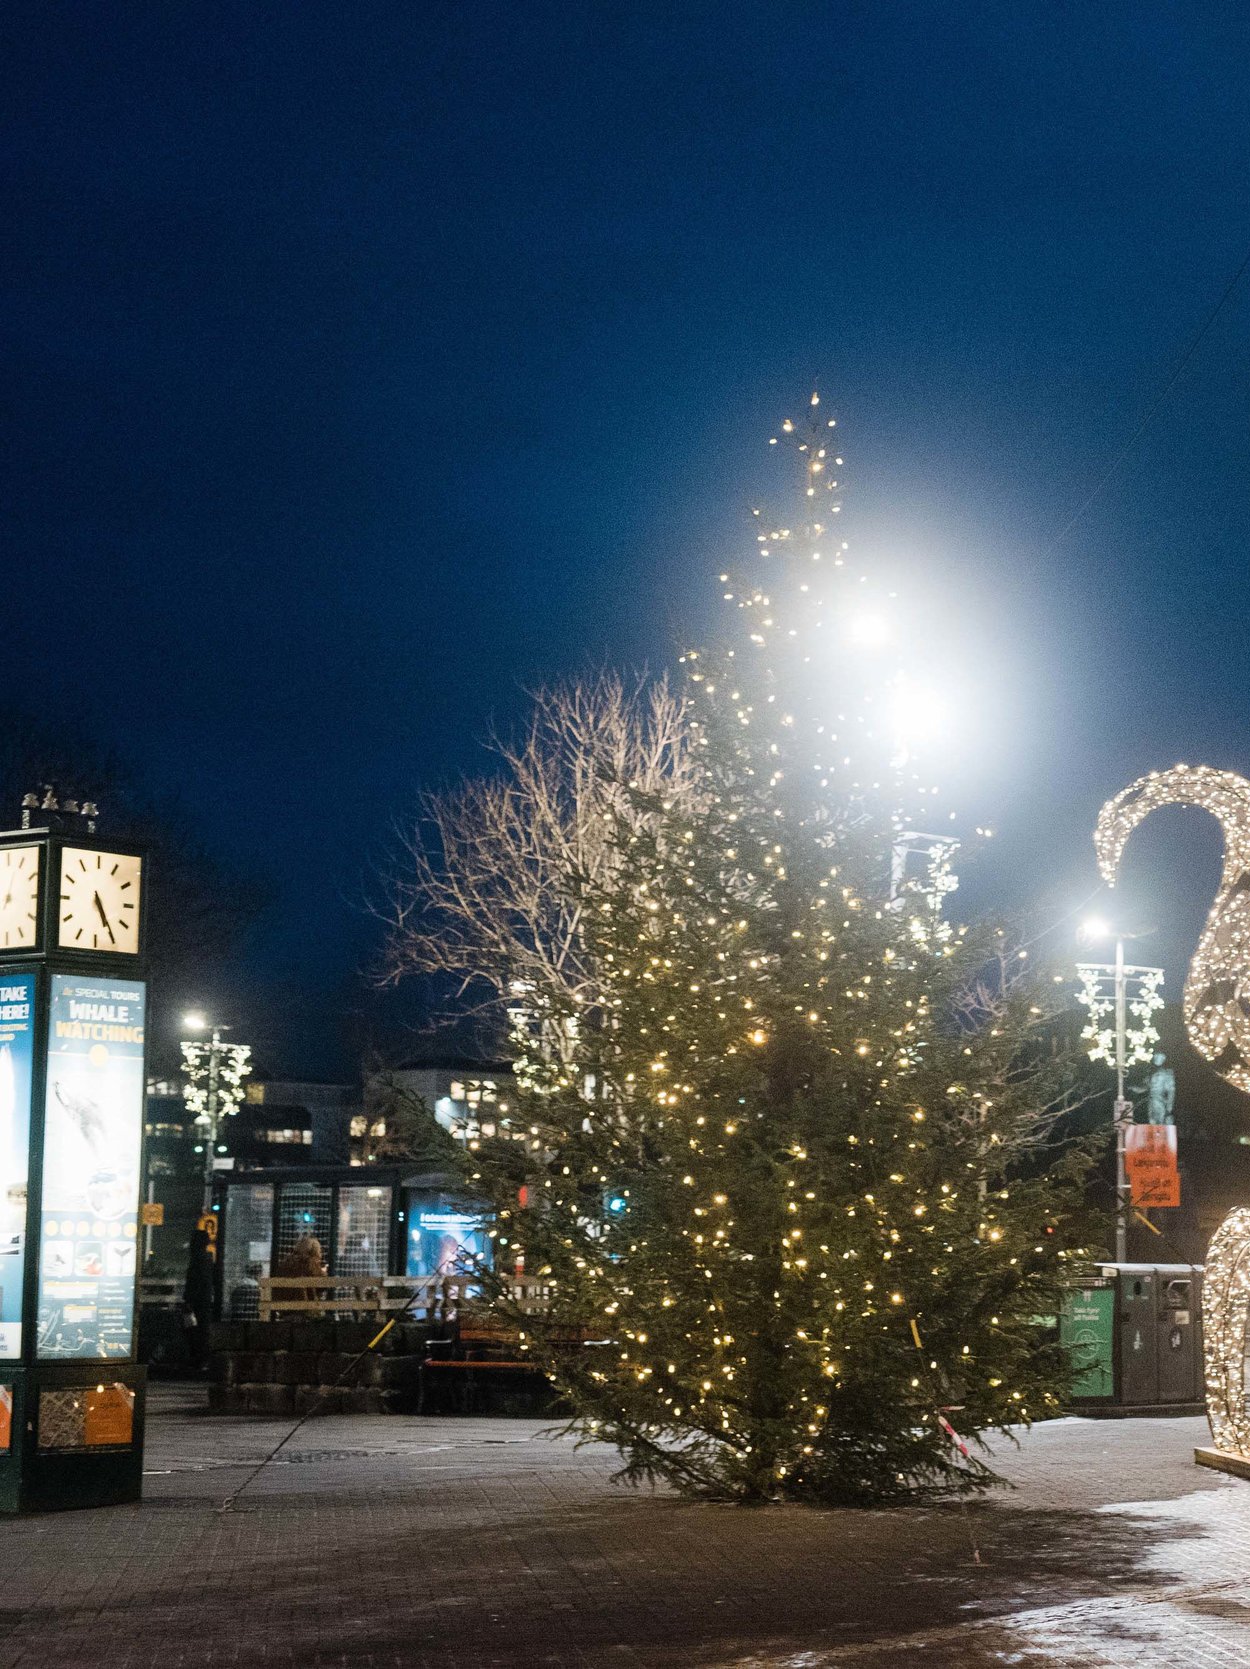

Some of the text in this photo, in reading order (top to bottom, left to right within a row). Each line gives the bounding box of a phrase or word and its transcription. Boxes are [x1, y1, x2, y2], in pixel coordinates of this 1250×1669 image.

[0, 986, 27, 1001] TAKE
[74, 987, 140, 1001] SPECIAL TOURS
[69, 1000, 129, 1022] WHALE
[56, 1021, 144, 1043] WATCHING
